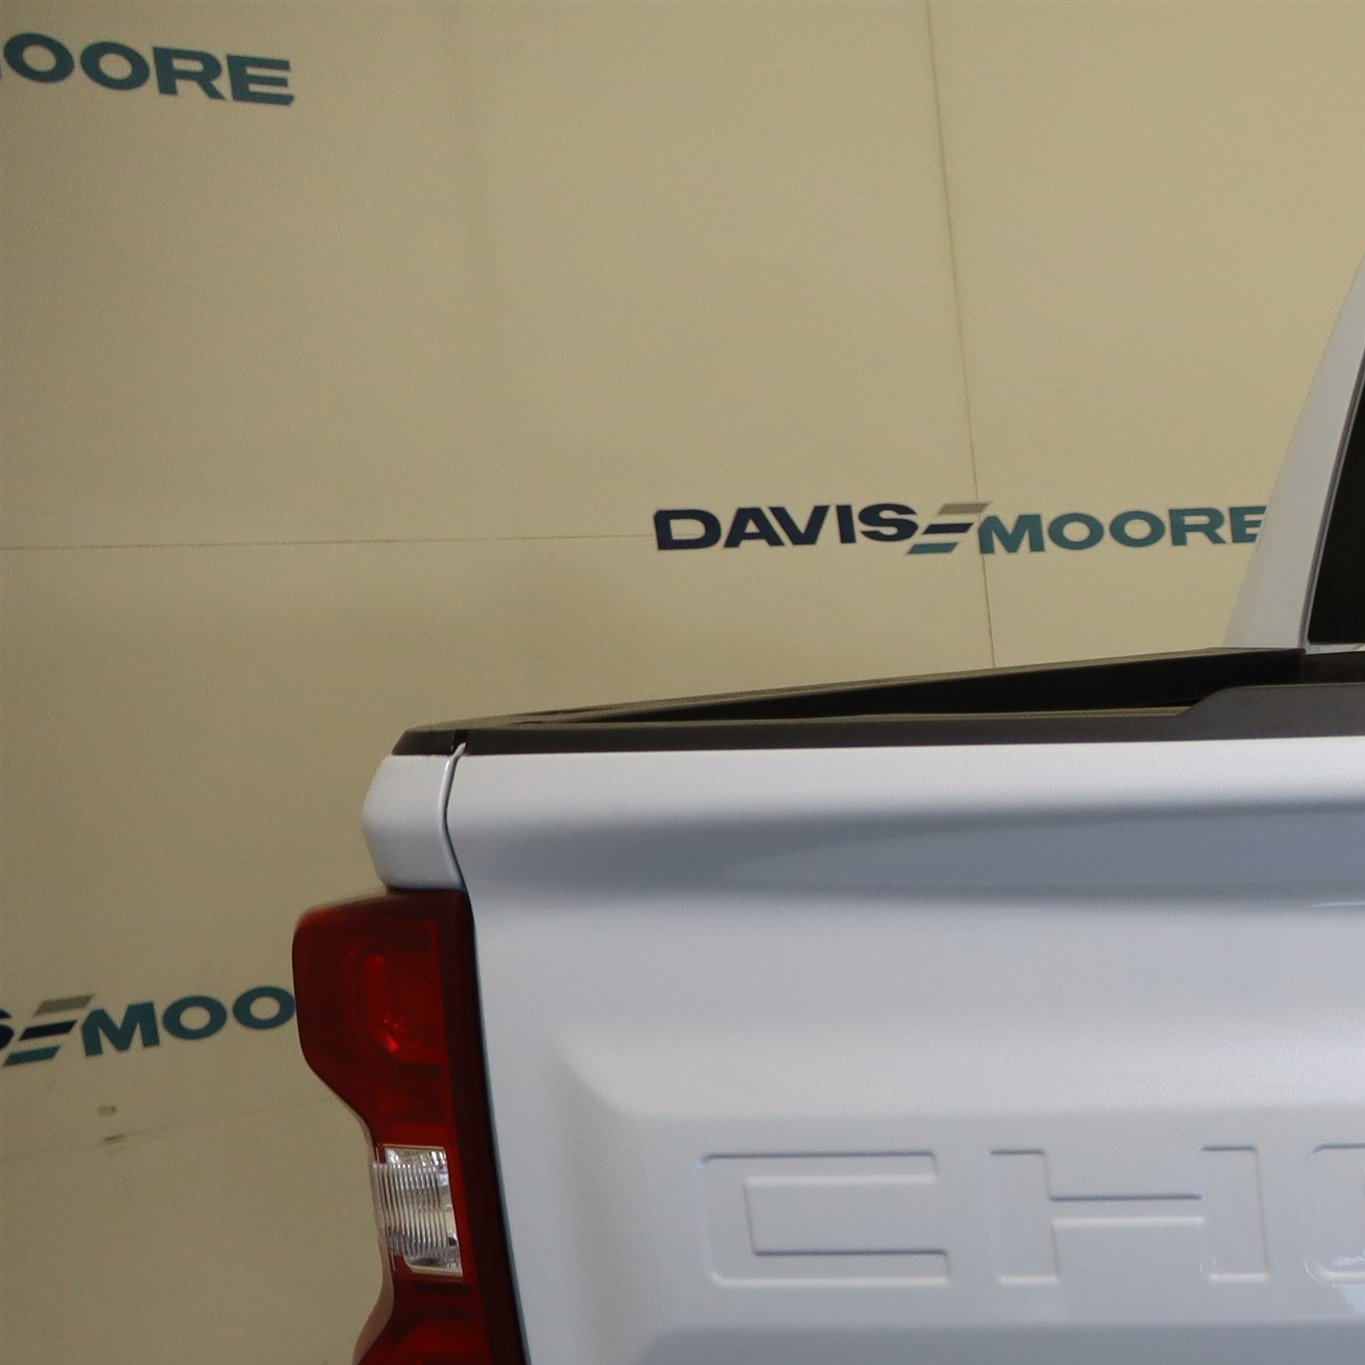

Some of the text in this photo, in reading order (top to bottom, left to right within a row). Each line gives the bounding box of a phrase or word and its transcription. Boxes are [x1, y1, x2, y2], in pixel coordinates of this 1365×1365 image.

[0, 31, 295, 106] OORE
[653, 503, 1267, 554] DAVIS MOORE
[81, 986, 296, 1056] MOO
